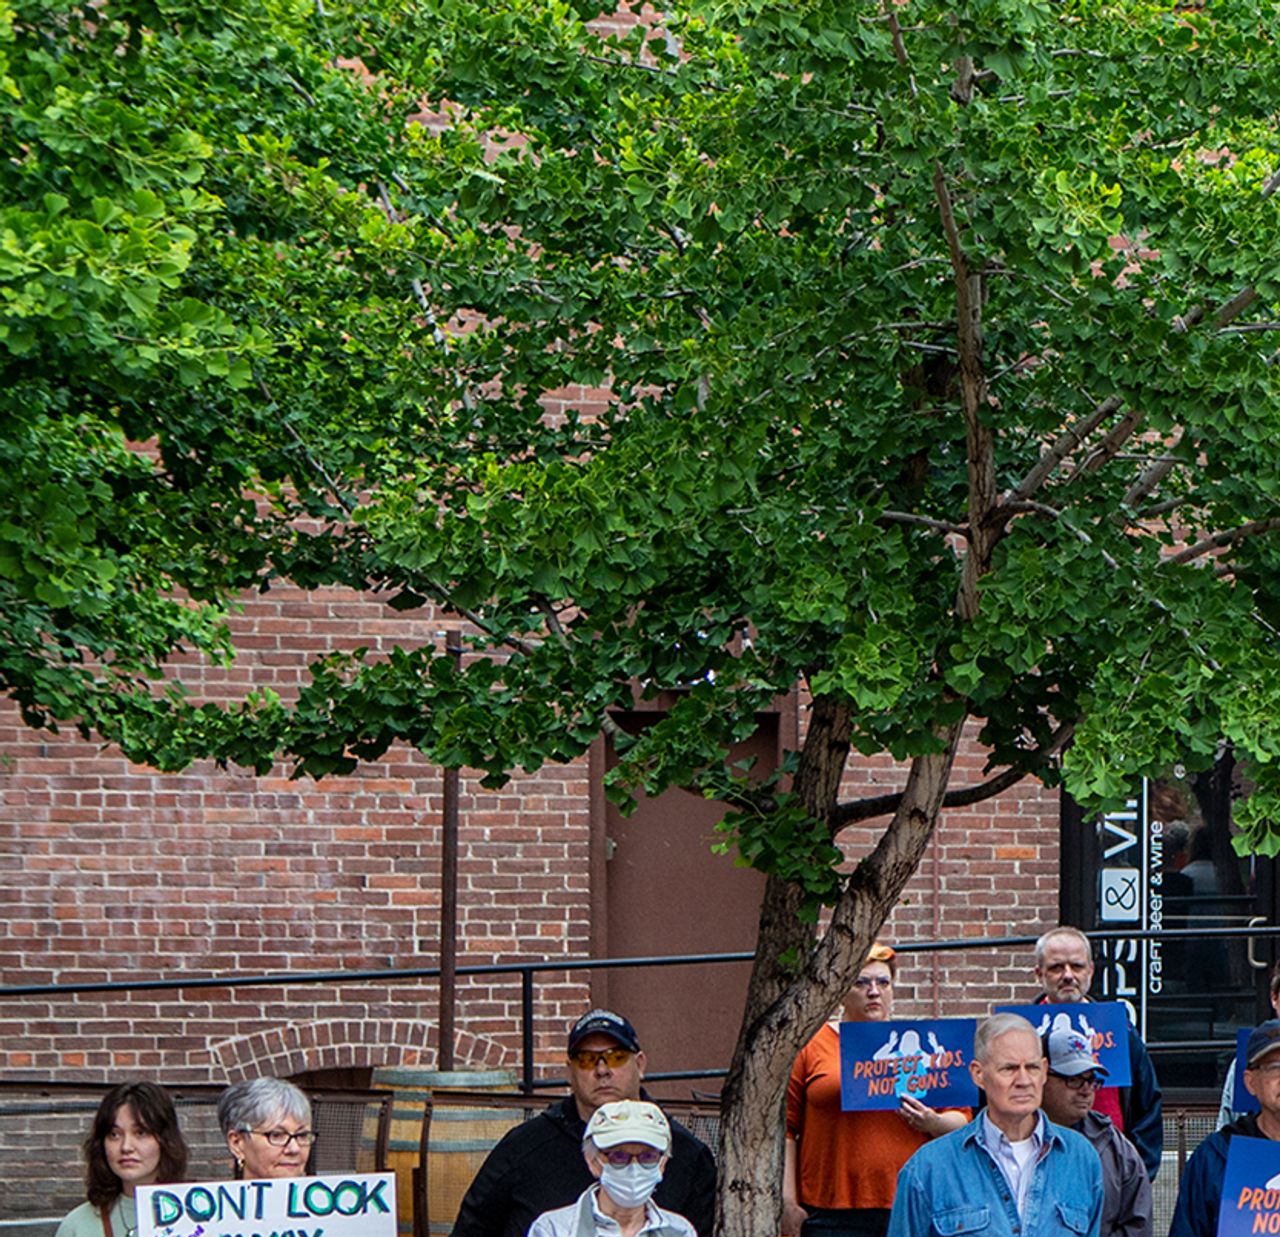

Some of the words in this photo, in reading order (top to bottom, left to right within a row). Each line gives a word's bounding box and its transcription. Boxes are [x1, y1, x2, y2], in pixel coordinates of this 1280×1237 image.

[1150, 871, 1163, 885] &
[854, 1056, 923, 1079] PROTECT
[867, 1077, 898, 1097] NOT
[287, 1179, 390, 1218] LOOK
